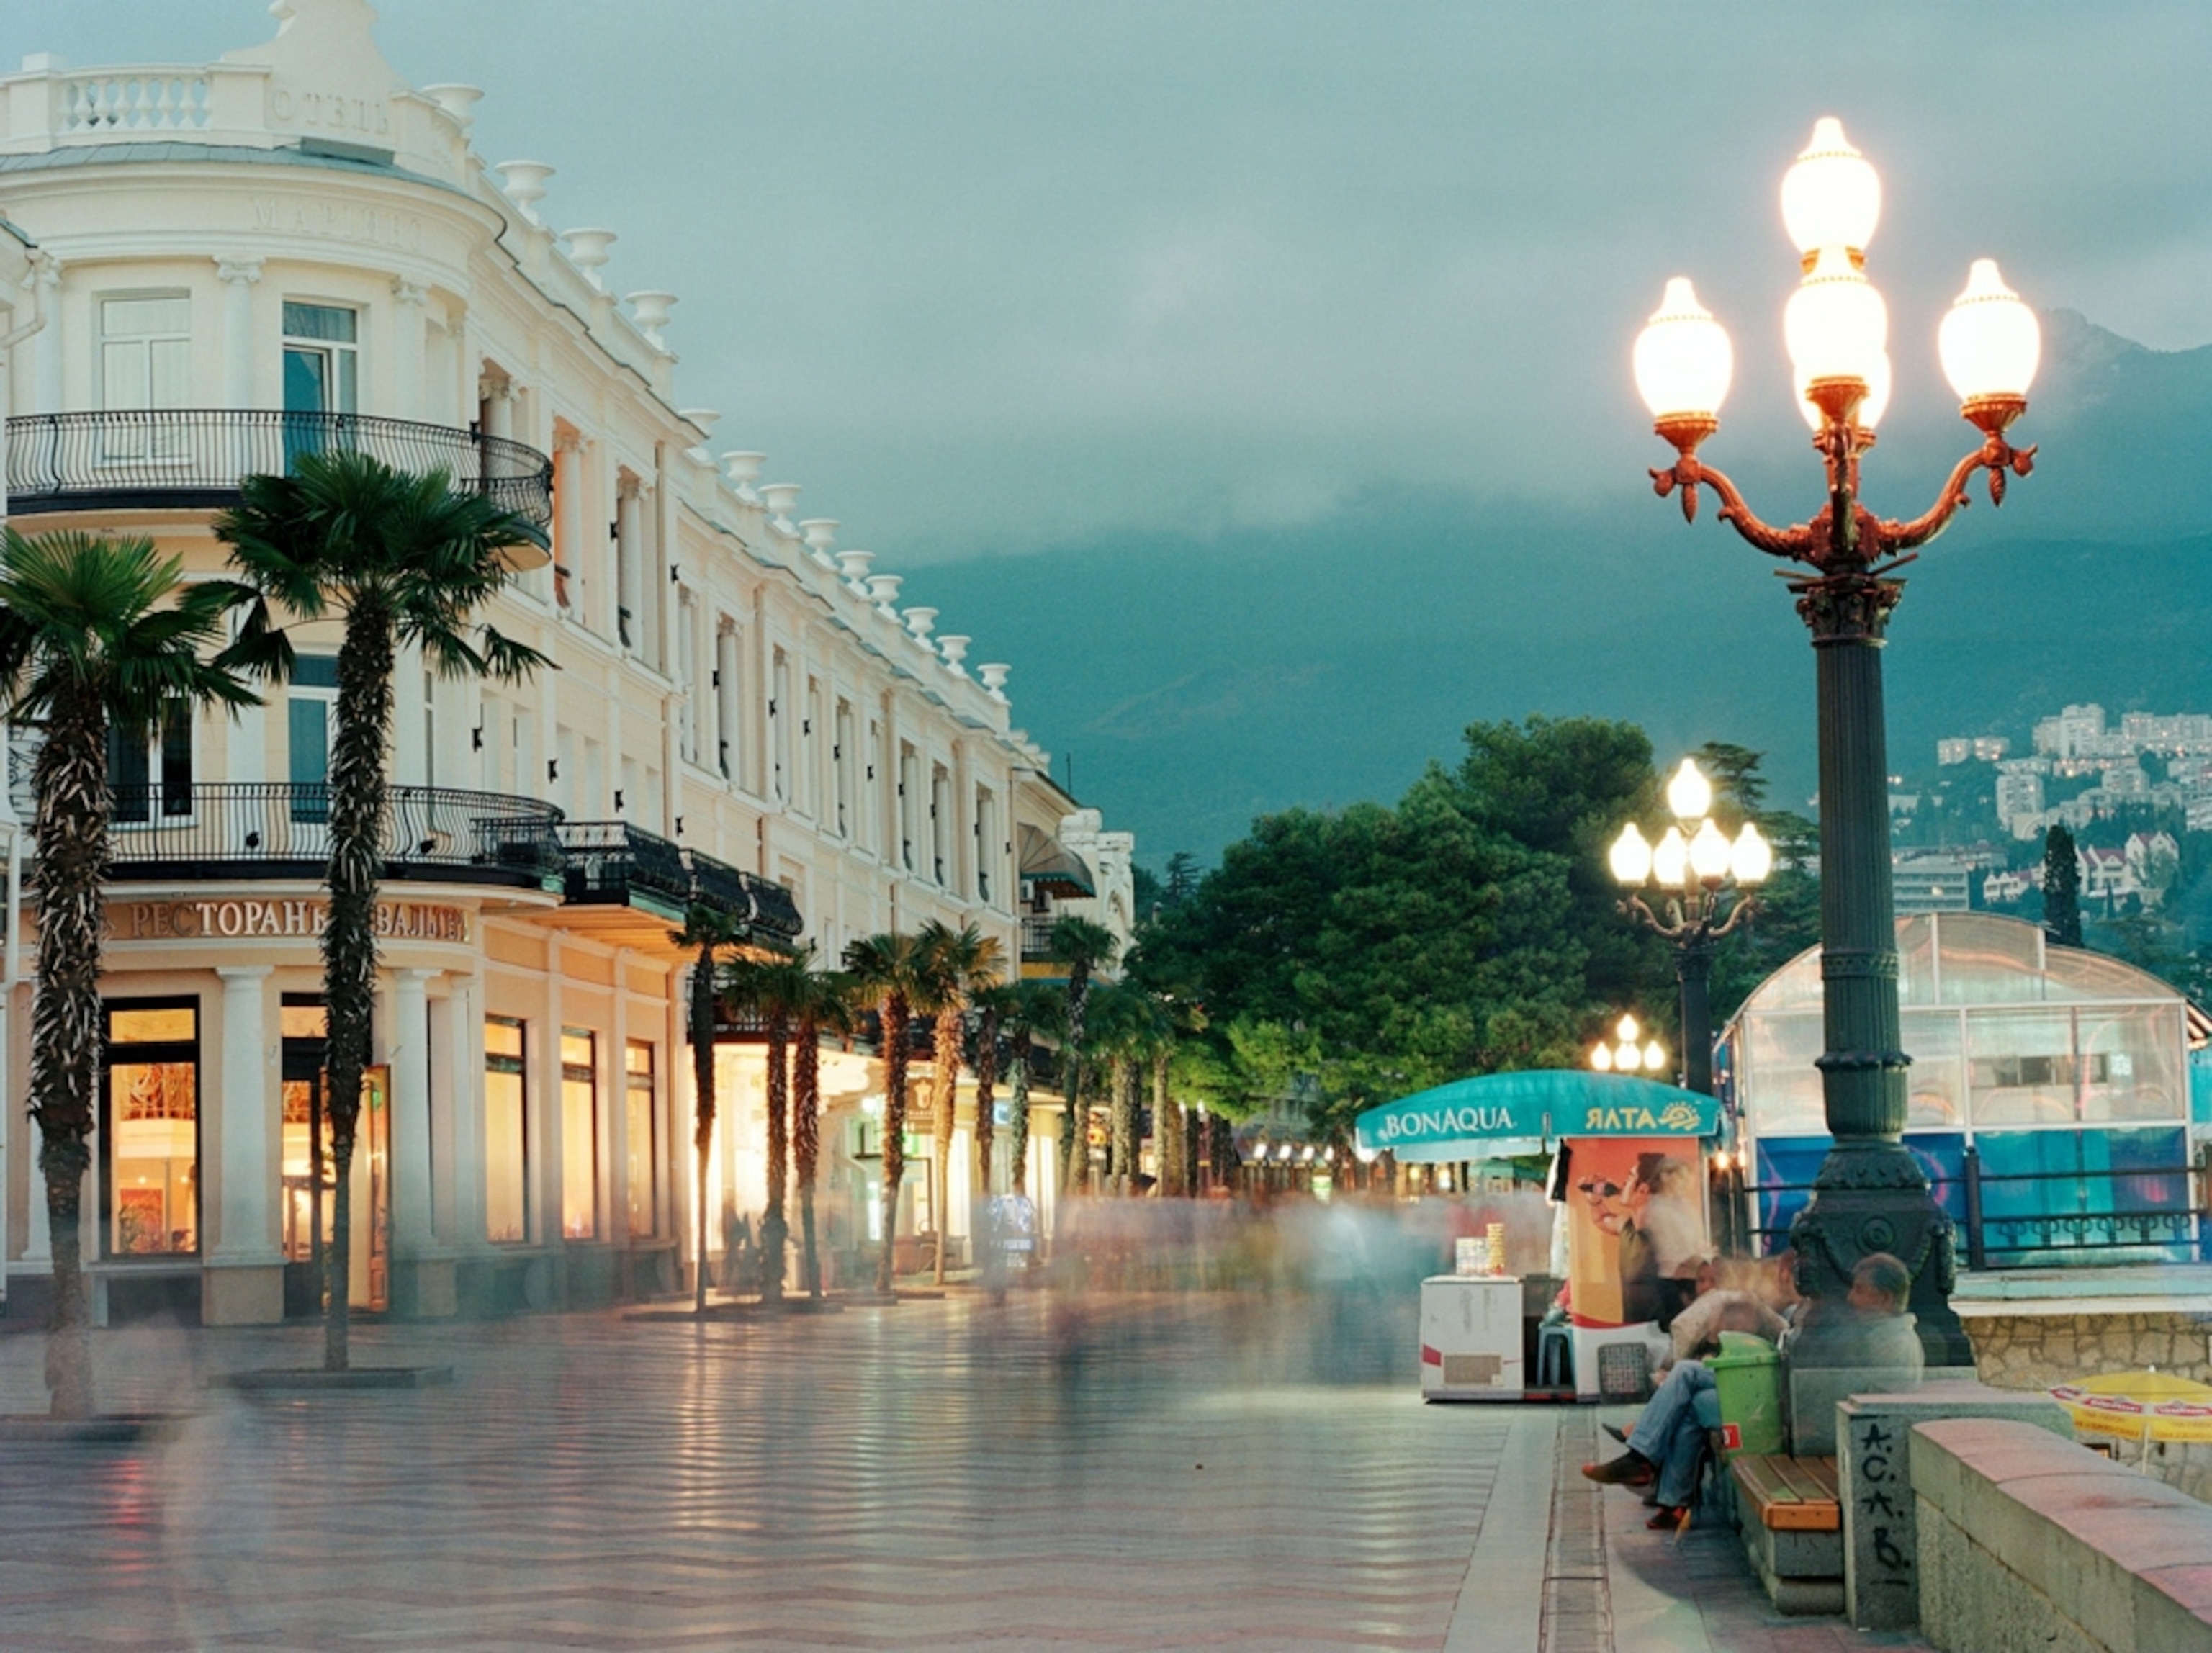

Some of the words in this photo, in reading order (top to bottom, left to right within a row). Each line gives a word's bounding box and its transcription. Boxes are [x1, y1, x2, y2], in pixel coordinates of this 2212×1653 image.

[272, 89, 390, 135] ОТЕЛЬ
[1385, 1106, 1513, 1139] BONAQUA
[1586, 1107, 1656, 1130] ЯЛТА
